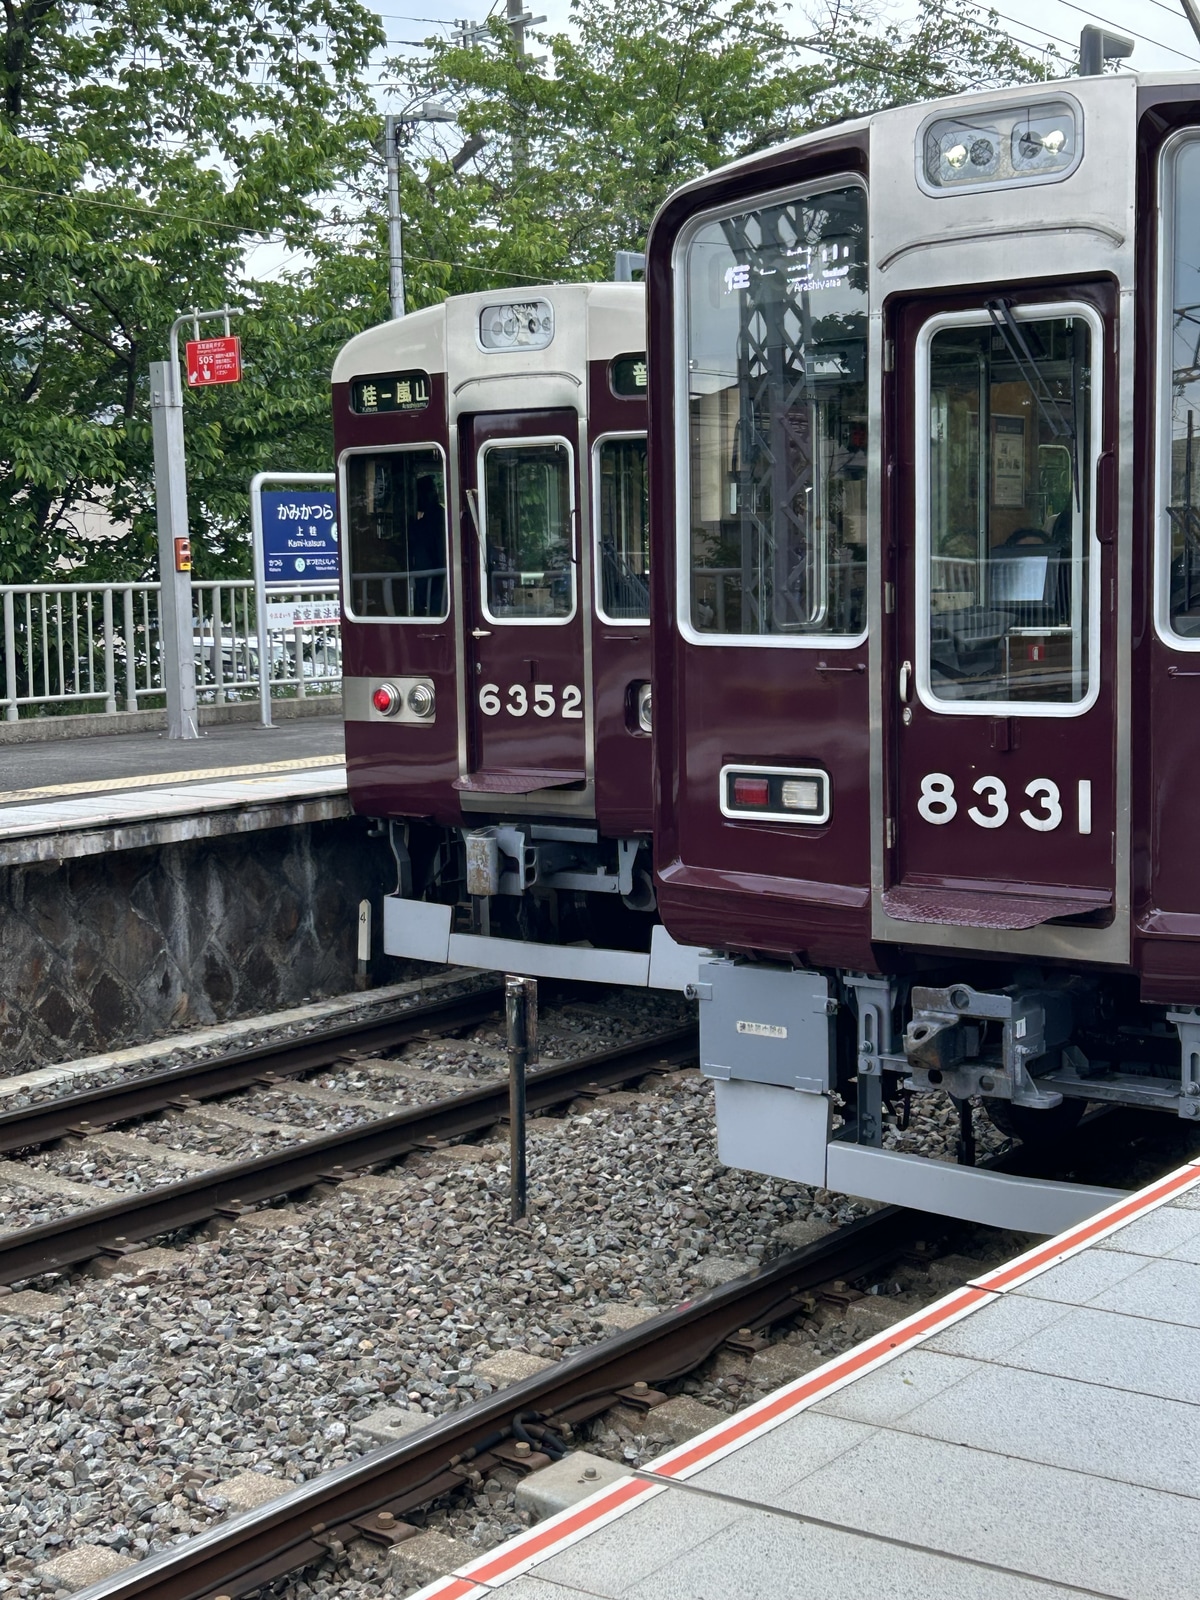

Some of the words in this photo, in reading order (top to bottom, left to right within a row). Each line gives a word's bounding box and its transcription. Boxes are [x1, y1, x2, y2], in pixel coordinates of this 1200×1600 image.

[198, 355, 214, 365] SOS
[276, 503, 334, 521] かみかつら
[287, 539, 326, 548] Kami-katsura
[479, 683, 583, 719] 6352
[917, 772, 1092, 835] 8331
[360, 911, 366, 924] 4
